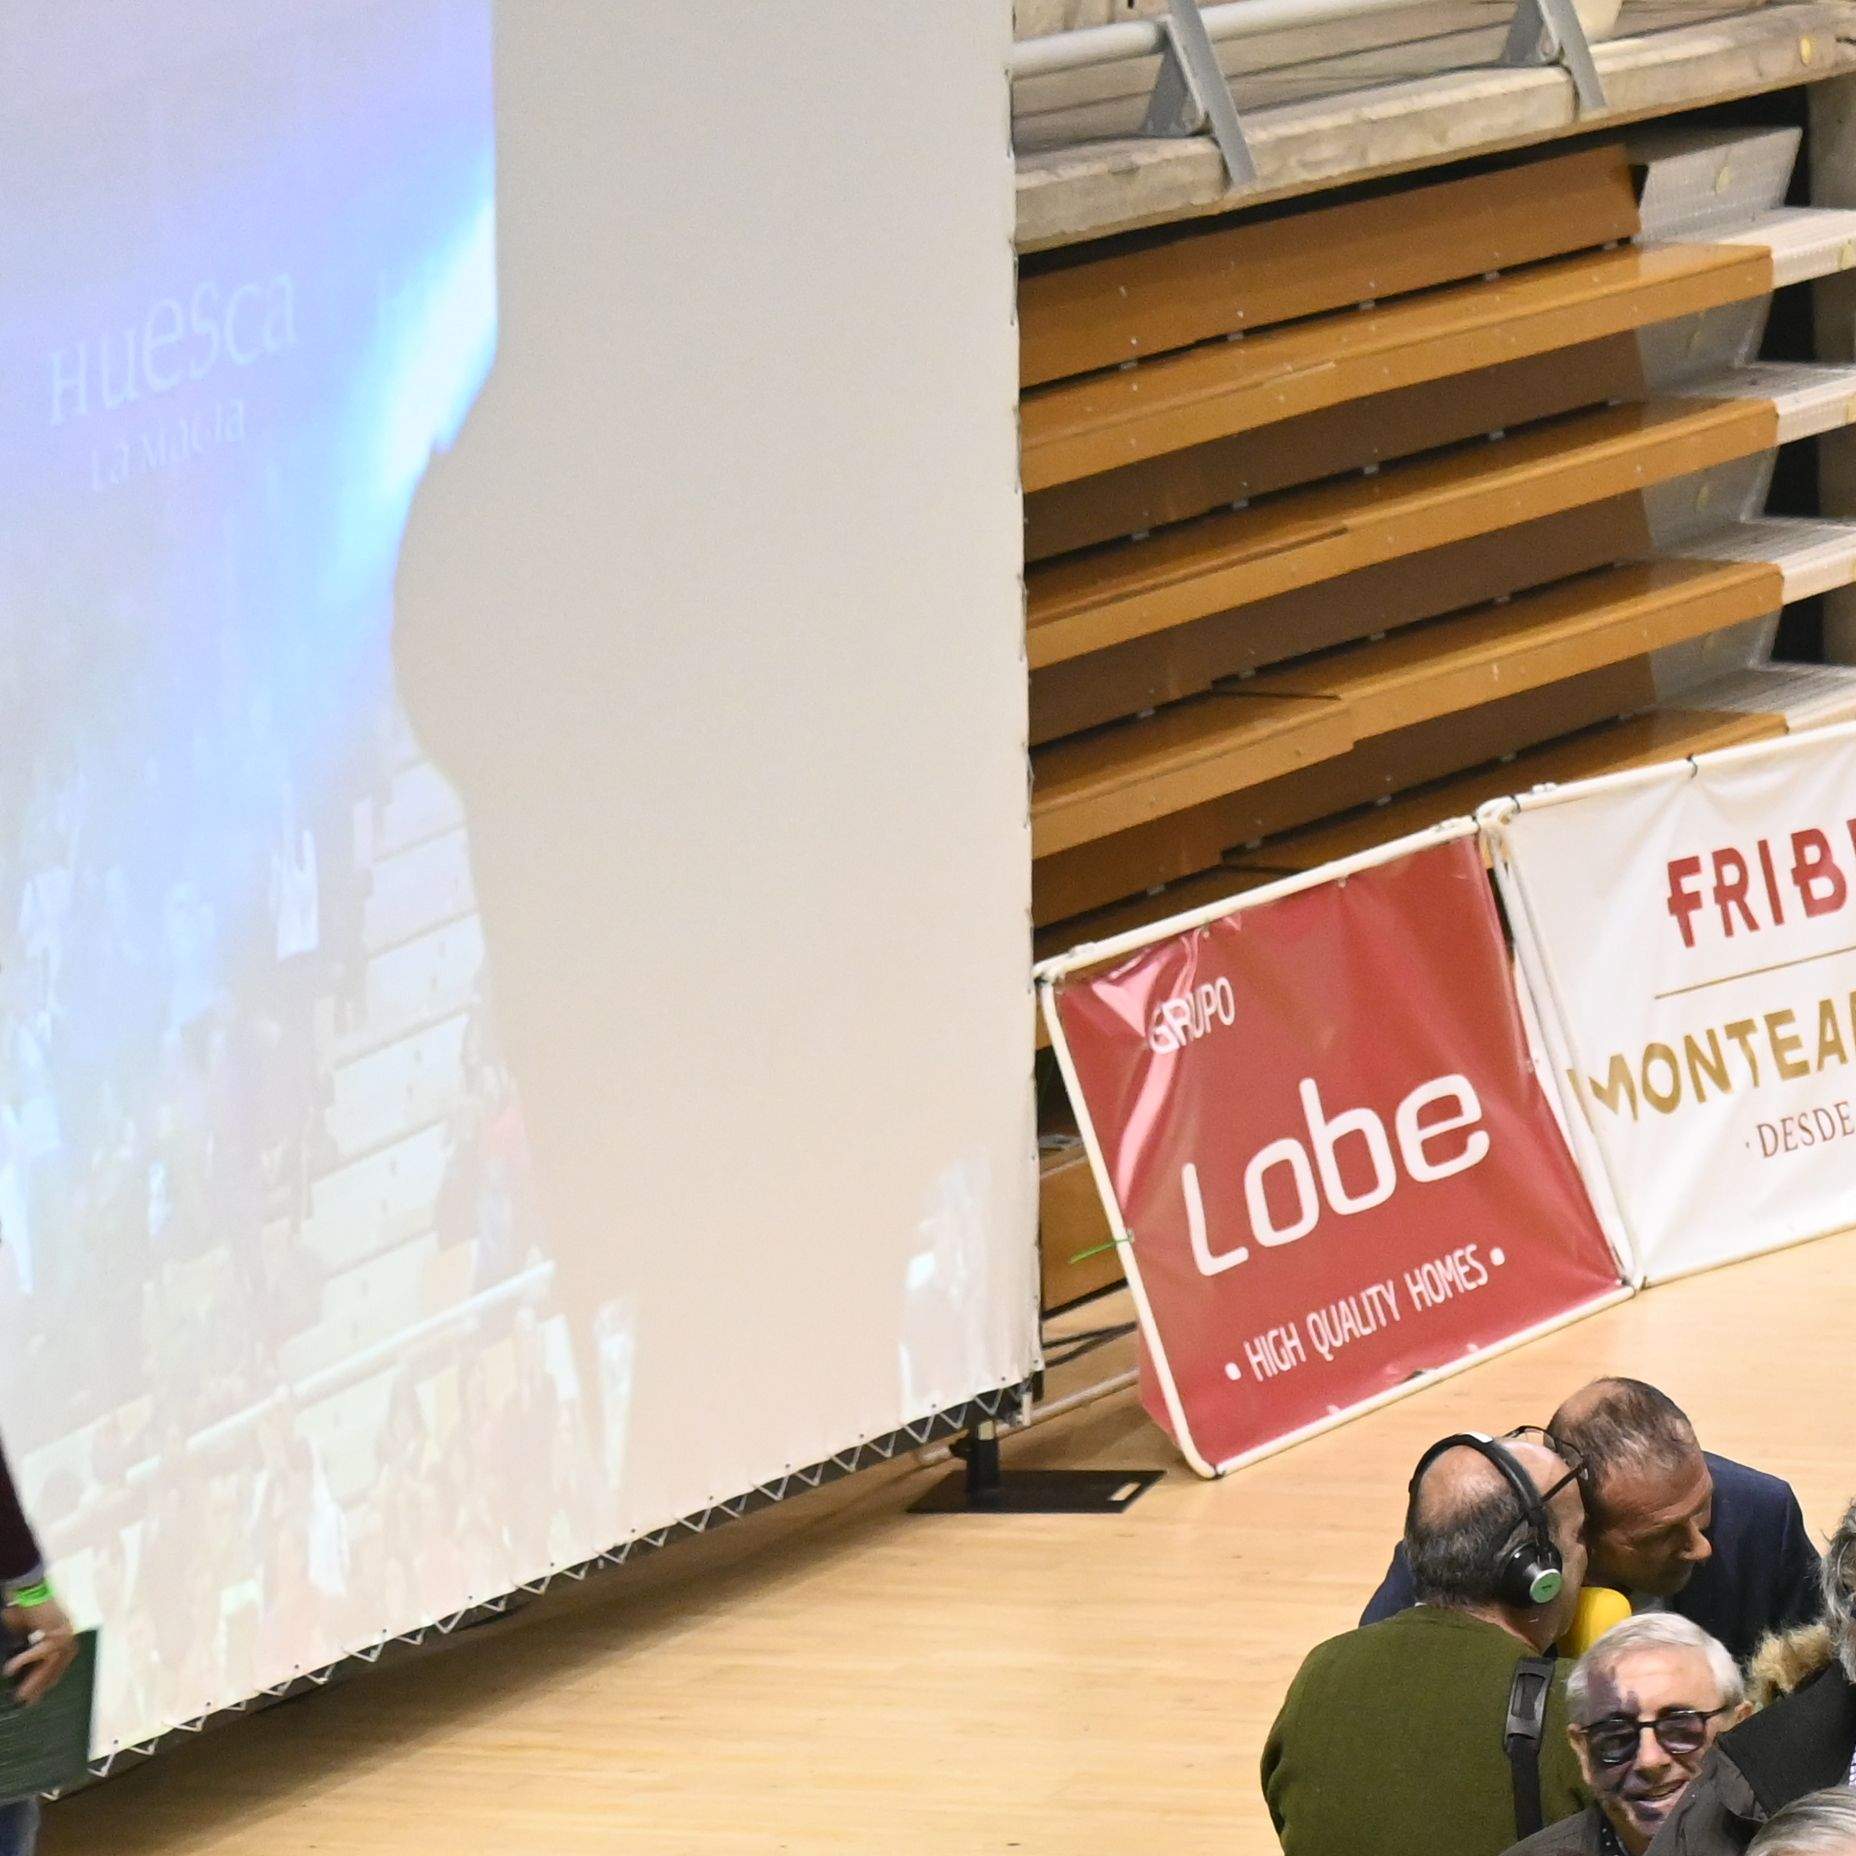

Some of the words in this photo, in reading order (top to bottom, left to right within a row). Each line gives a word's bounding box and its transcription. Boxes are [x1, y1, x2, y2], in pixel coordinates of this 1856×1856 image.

[1146, 976, 1236, 1055] GRUPO
[1182, 1073, 1491, 1276] Lobe
[1757, 1099, 1855, 1159] DESDE
[1244, 1320, 1304, 1382] HIGH
[1307, 1278, 1400, 1362] QUALITY
[1406, 1242, 1489, 1312] HOMES
